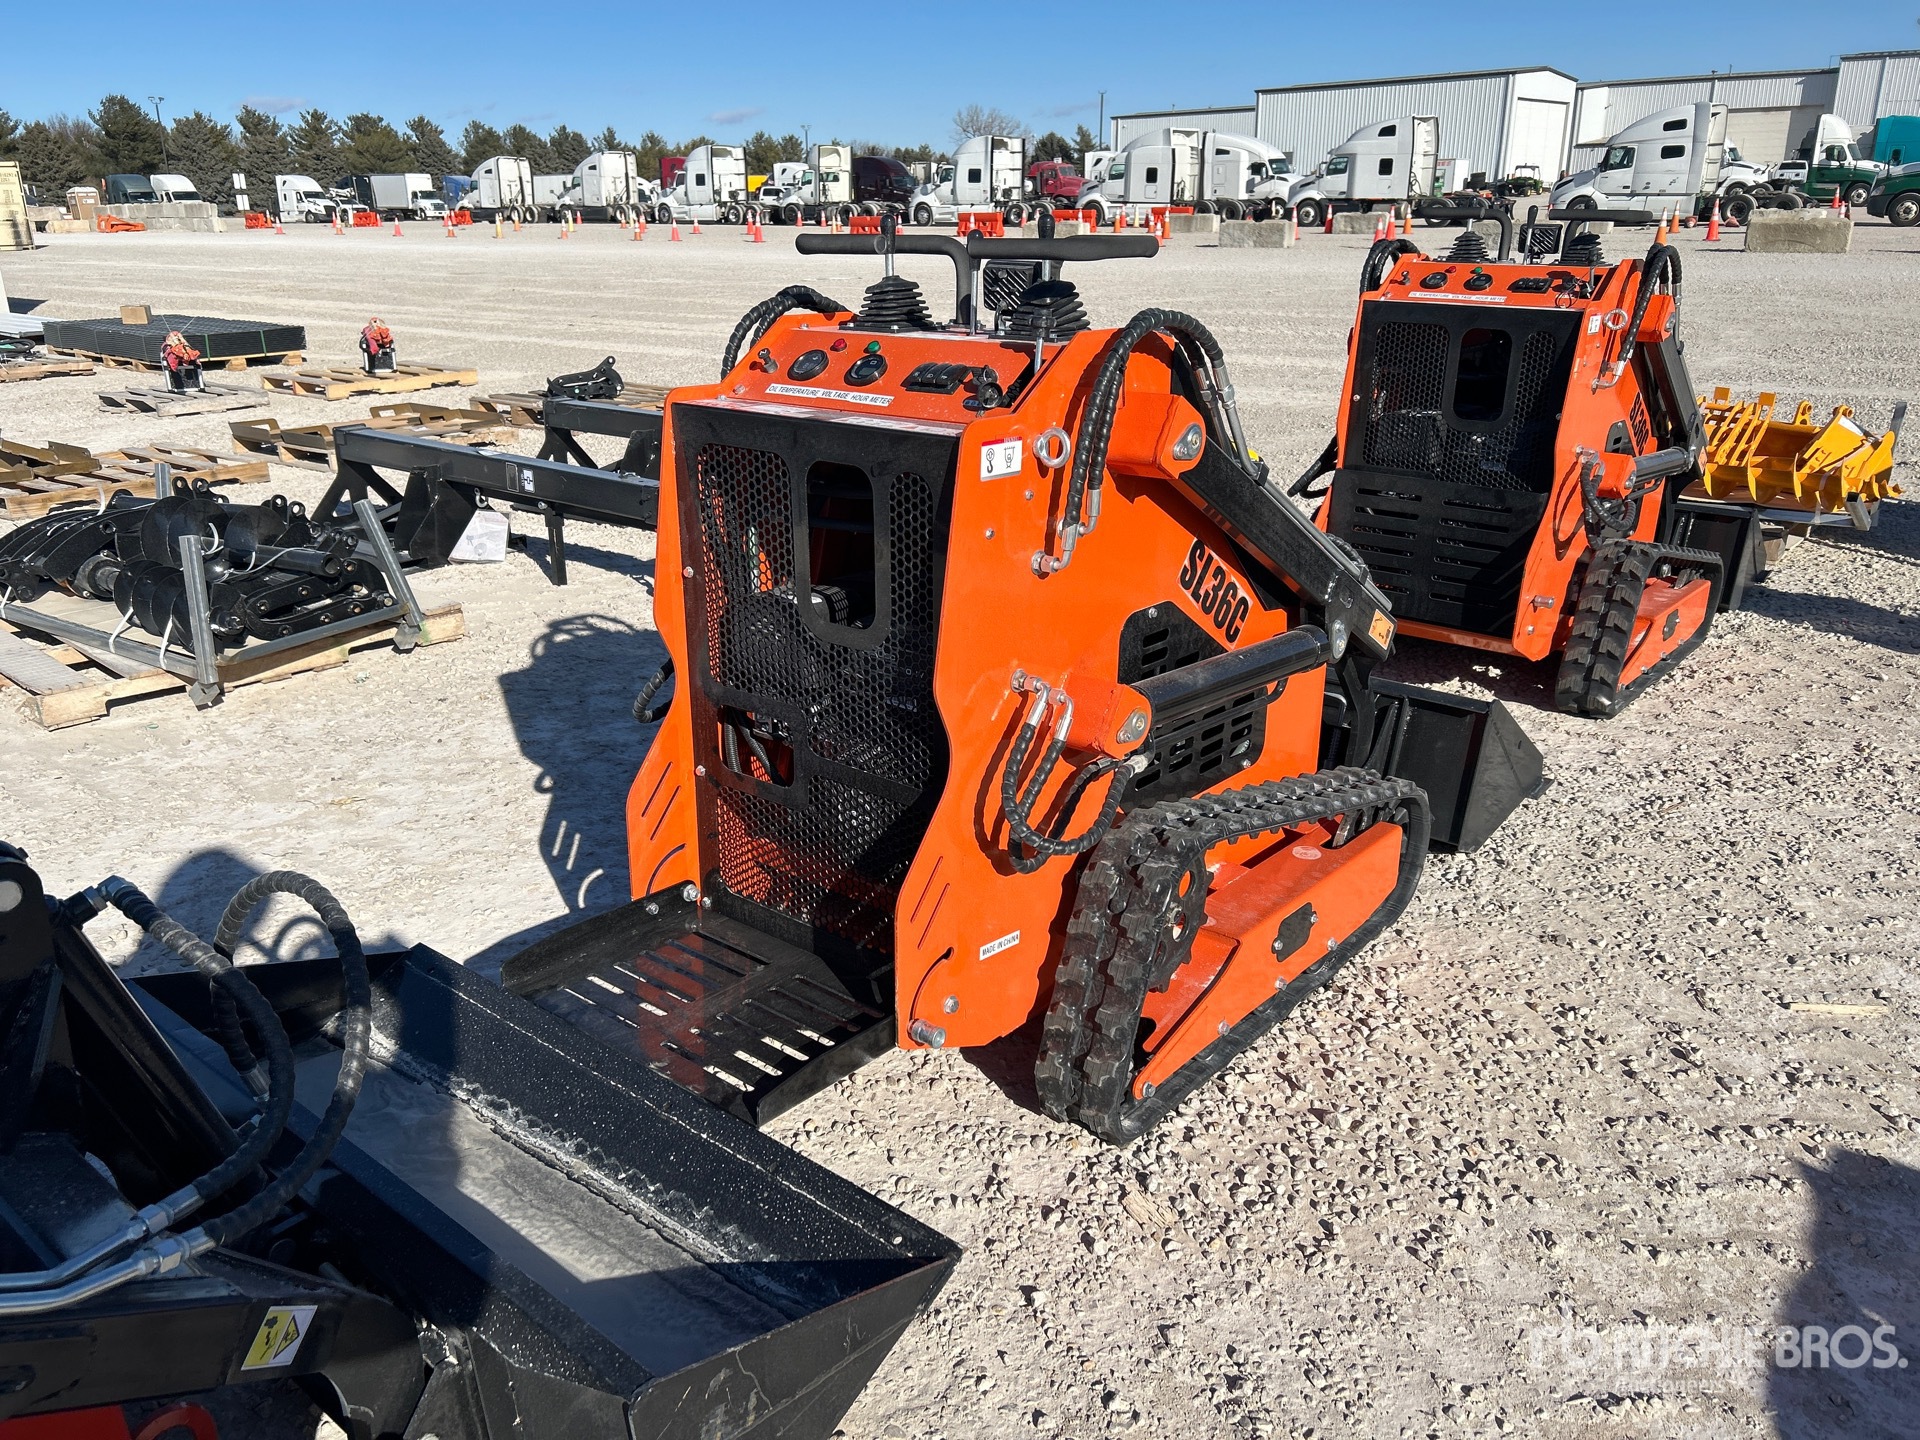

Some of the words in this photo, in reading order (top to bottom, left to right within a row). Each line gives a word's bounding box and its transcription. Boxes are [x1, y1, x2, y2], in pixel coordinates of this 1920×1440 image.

[778, 386, 820, 397] TEMPERATURE
[851, 394, 870, 402] HOUR
[869, 396, 893, 405] METER
[1179, 539, 1250, 644] SL36C
[982, 943, 996, 957] MADE
[996, 940, 1004, 949] IN
[1003, 933, 1019, 947] CHINA
